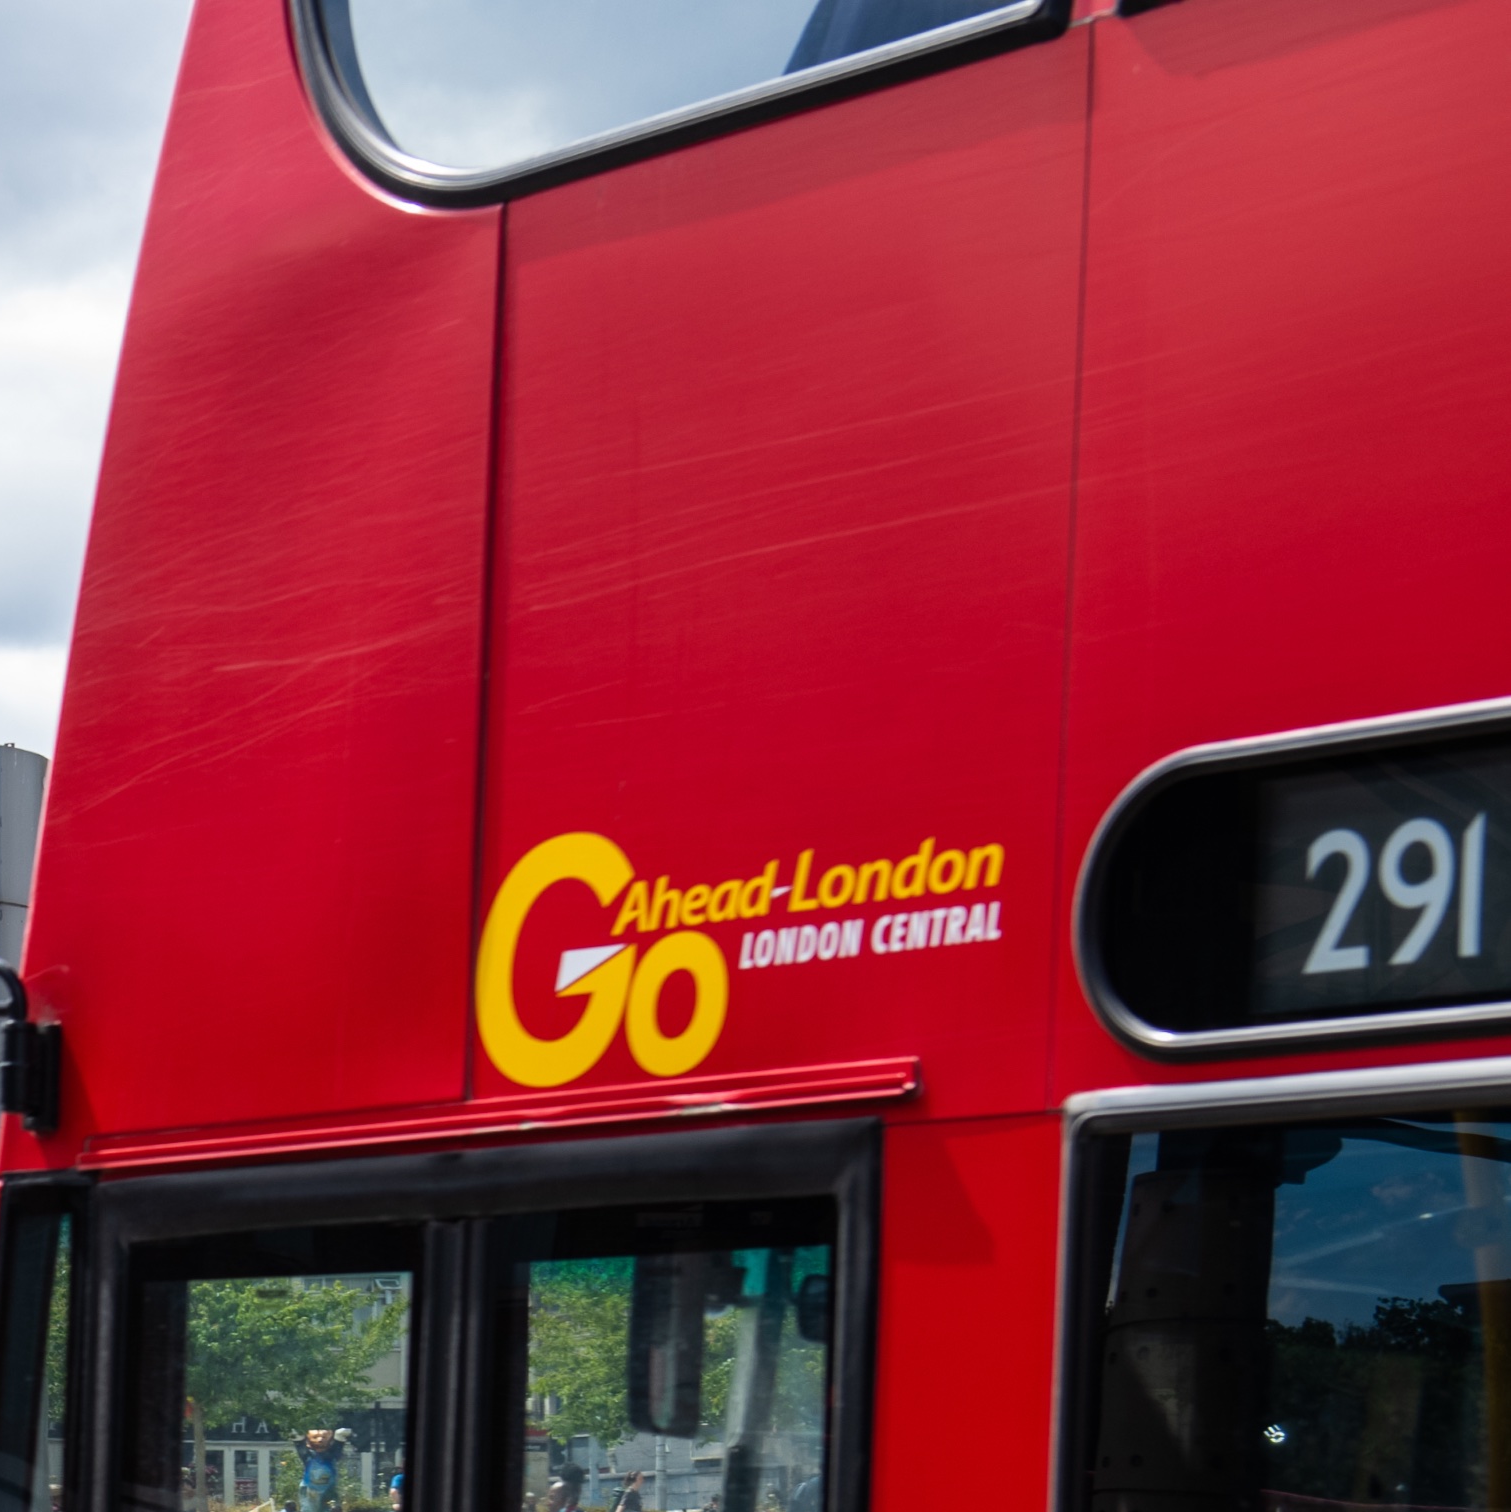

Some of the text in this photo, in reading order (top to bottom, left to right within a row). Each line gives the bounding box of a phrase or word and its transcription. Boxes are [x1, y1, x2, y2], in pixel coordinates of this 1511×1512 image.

[610, 837, 1005, 937] Ahead-London
[738, 901, 1002, 970] LONDON CENTRAL
[1302, 812, 1487, 975] 291
[477, 832, 729, 1088] Go
